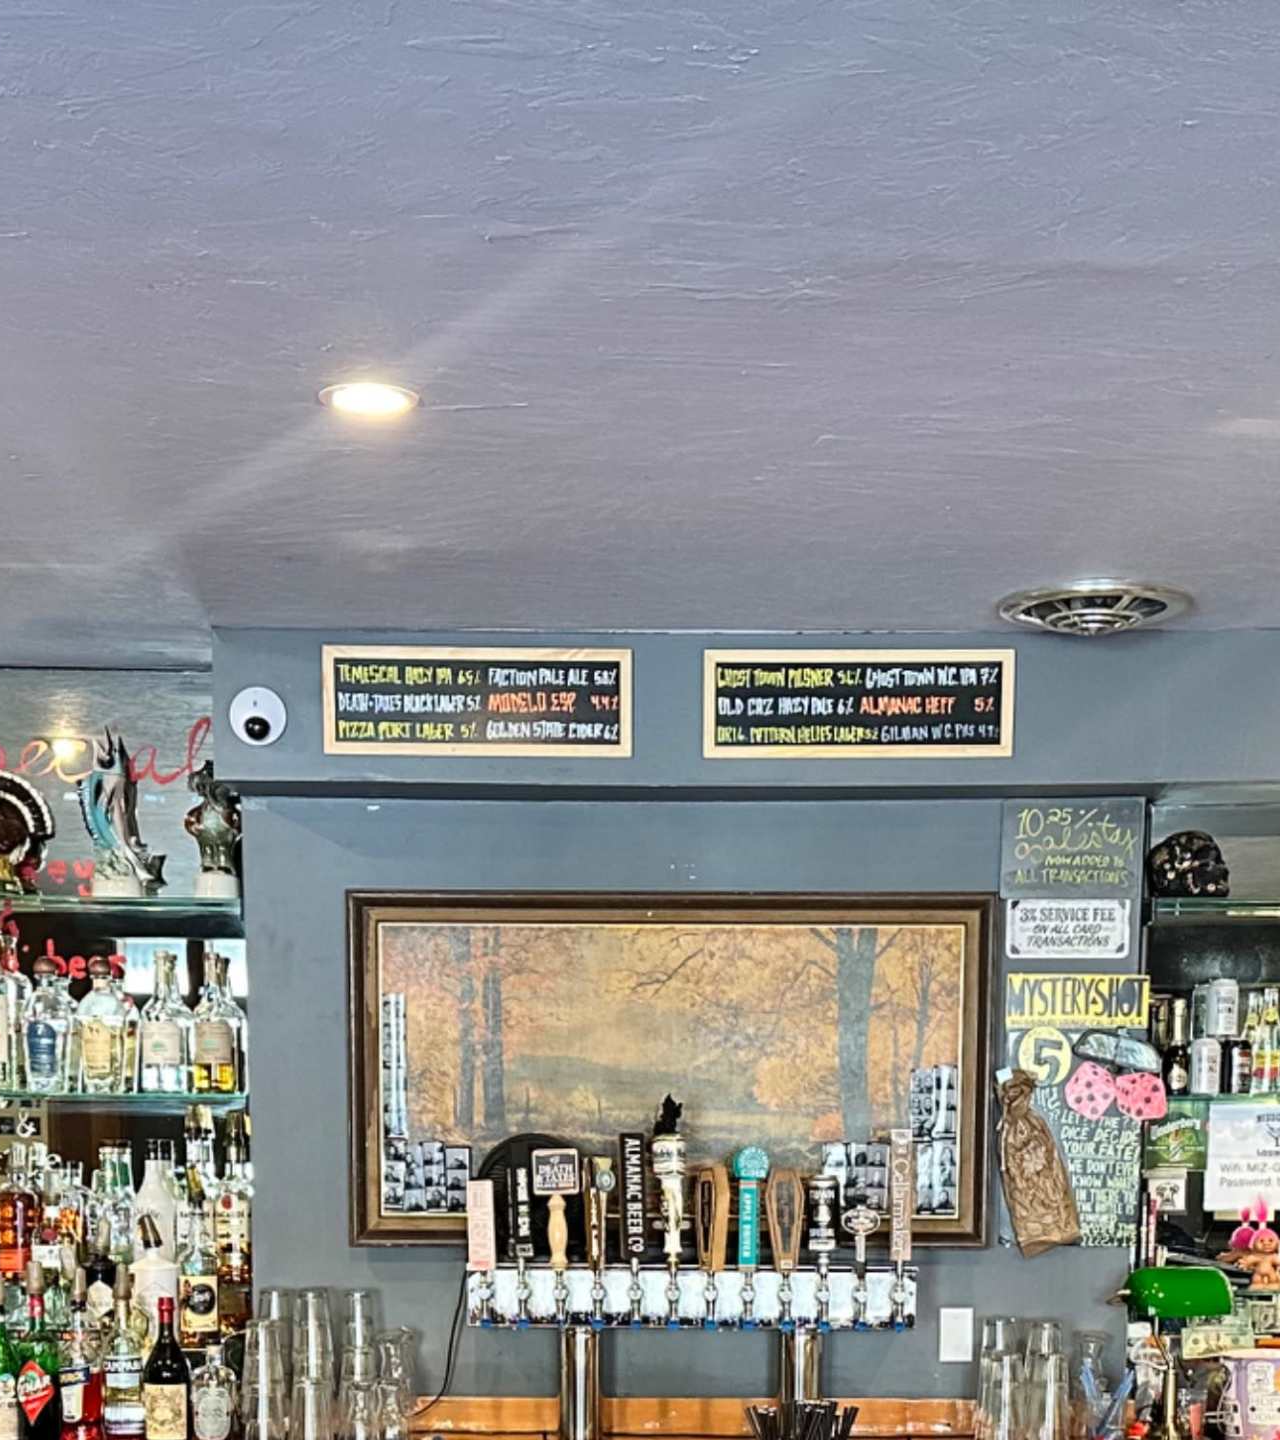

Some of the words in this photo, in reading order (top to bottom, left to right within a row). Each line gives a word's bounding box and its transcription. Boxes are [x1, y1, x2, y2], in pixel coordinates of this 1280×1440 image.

[336, 664, 402, 685] TEMESCAL
[436, 667, 452, 686] IPA
[488, 667, 537, 687] FACTION
[539, 667, 565, 685] PALE
[568, 668, 589, 687] ALE
[787, 667, 835, 688] PILSNER
[960, 667, 977, 686] IPA
[980, 667, 999, 686] 7%
[488, 691, 547, 713] MODELO
[717, 696, 744, 716] OLD
[778, 696, 810, 716] HAZY
[811, 697, 834, 716] PALE
[837, 696, 854, 715] 6%
[860, 695, 922, 716] ALMANAC
[974, 696, 995, 713] 5%
[337, 720, 376, 740] PIZZA
[416, 721, 454, 741] LAGER
[460, 721, 479, 740] 5%
[486, 719, 530, 740] GOLDEN
[533, 719, 566, 739] STATE
[568, 721, 603, 740] CIDER
[603, 722, 619, 741] 6%
[881, 725, 929, 743] GILMAN
[1015, 869, 1037, 885] ALL
[1020, 909, 1037, 922] 3%
[1040, 908, 1089, 923] SERVICE
[1093, 908, 1115, 922] FEE
[1052, 924, 1068, 934] ALL
[1073, 924, 1102, 935] CARD
[1027, 935, 1110, 948] TRANSACTIONS
[1008, 977, 1093, 1017] MYSTERY
[1094, 977, 1149, 1018] SHOT
[1034, 1038, 1064, 1088] 5
[1061, 1125, 1089, 1141] DICE
[1093, 1126, 1141, 1146] DECIDE
[1063, 1140, 1096, 1156] YOUR
[624, 1138, 643, 1200] ALMANAC
[626, 1202, 644, 1235] BEER
